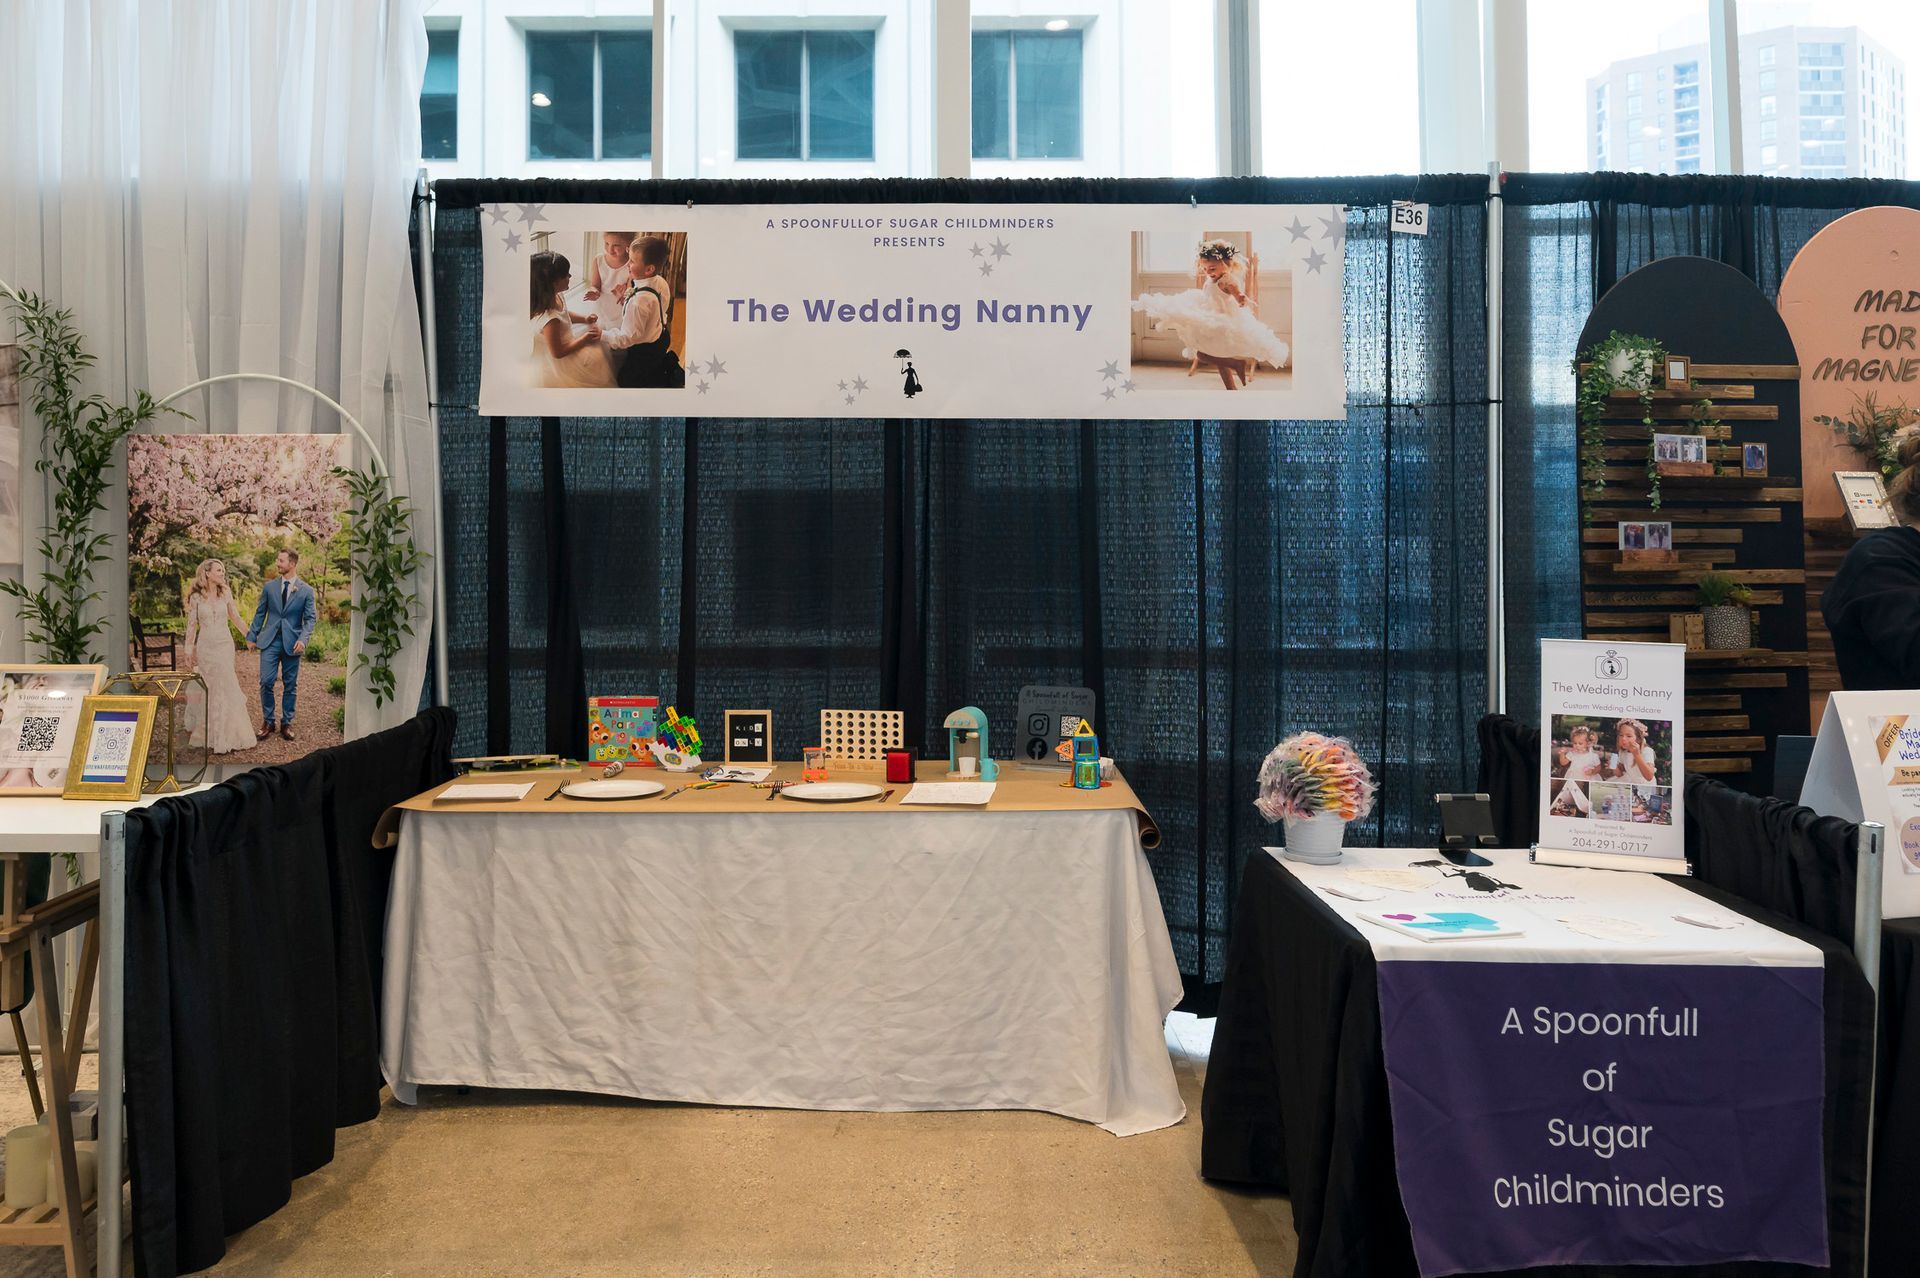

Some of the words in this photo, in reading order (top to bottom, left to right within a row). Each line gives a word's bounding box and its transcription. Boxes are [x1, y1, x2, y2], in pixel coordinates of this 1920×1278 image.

[766, 219, 775, 229] A
[781, 218, 883, 229] SPOONFULLOF
[889, 218, 938, 229] SUGAR
[944, 218, 1055, 229] CHILDMINDERS
[1395, 207, 1423, 226] E36
[873, 237, 945, 248] PRESENTS
[727, 298, 790, 323] The
[803, 296, 961, 332] Wedding
[976, 299, 1093, 332] Nanny
[1861, 323, 1917, 350] FOR
[1552, 682, 1573, 693] The
[1576, 684, 1629, 698] Wedding
[1633, 686, 1673, 700] Nanny
[604, 709, 643, 719] Animal
[1562, 702, 1590, 710] Custom
[1592, 703, 1624, 713] Wedding
[1625, 705, 1662, 714] Childcare
[611, 720, 636, 729] Pairs
[735, 724, 762, 732] KIDS
[1883, 723, 1900, 748] OFFER
[1572, 837, 1649, 853] 204-291-0717
[1501, 1007, 1524, 1036] A
[1533, 1006, 1699, 1044] Spoonfull
[1582, 1062, 1618, 1093] of
[1547, 1118, 1654, 1159] Sugar
[1494, 1174, 1725, 1209] Childminders
